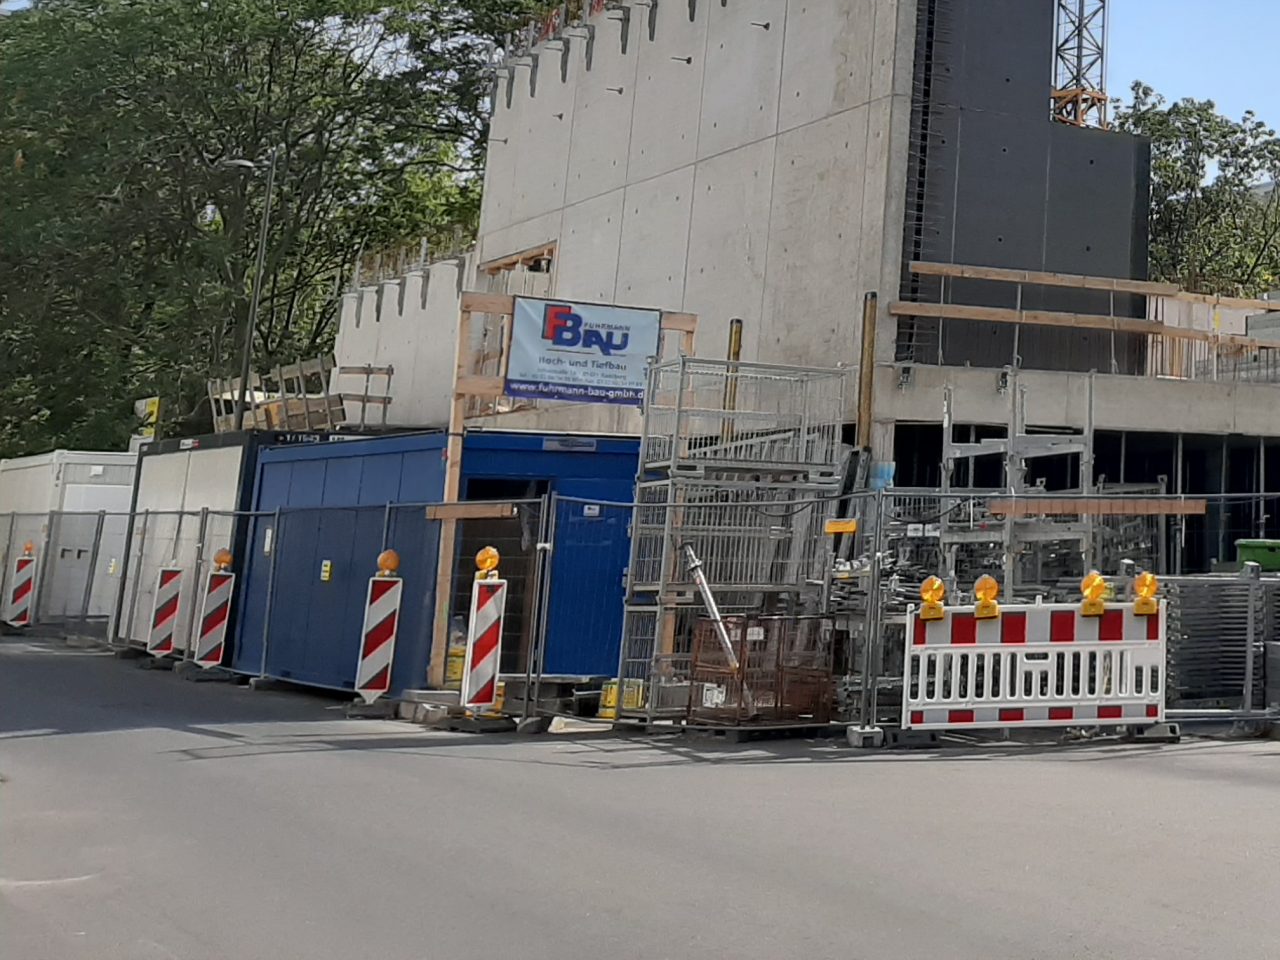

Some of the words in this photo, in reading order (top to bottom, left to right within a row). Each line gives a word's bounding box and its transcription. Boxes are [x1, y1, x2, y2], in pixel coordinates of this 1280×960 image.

[569, 359, 588, 368] und
[591, 360, 627, 371] Tiefbau
[509, 381, 644, 399] www.fuhrmann-bau-gmbh.d
